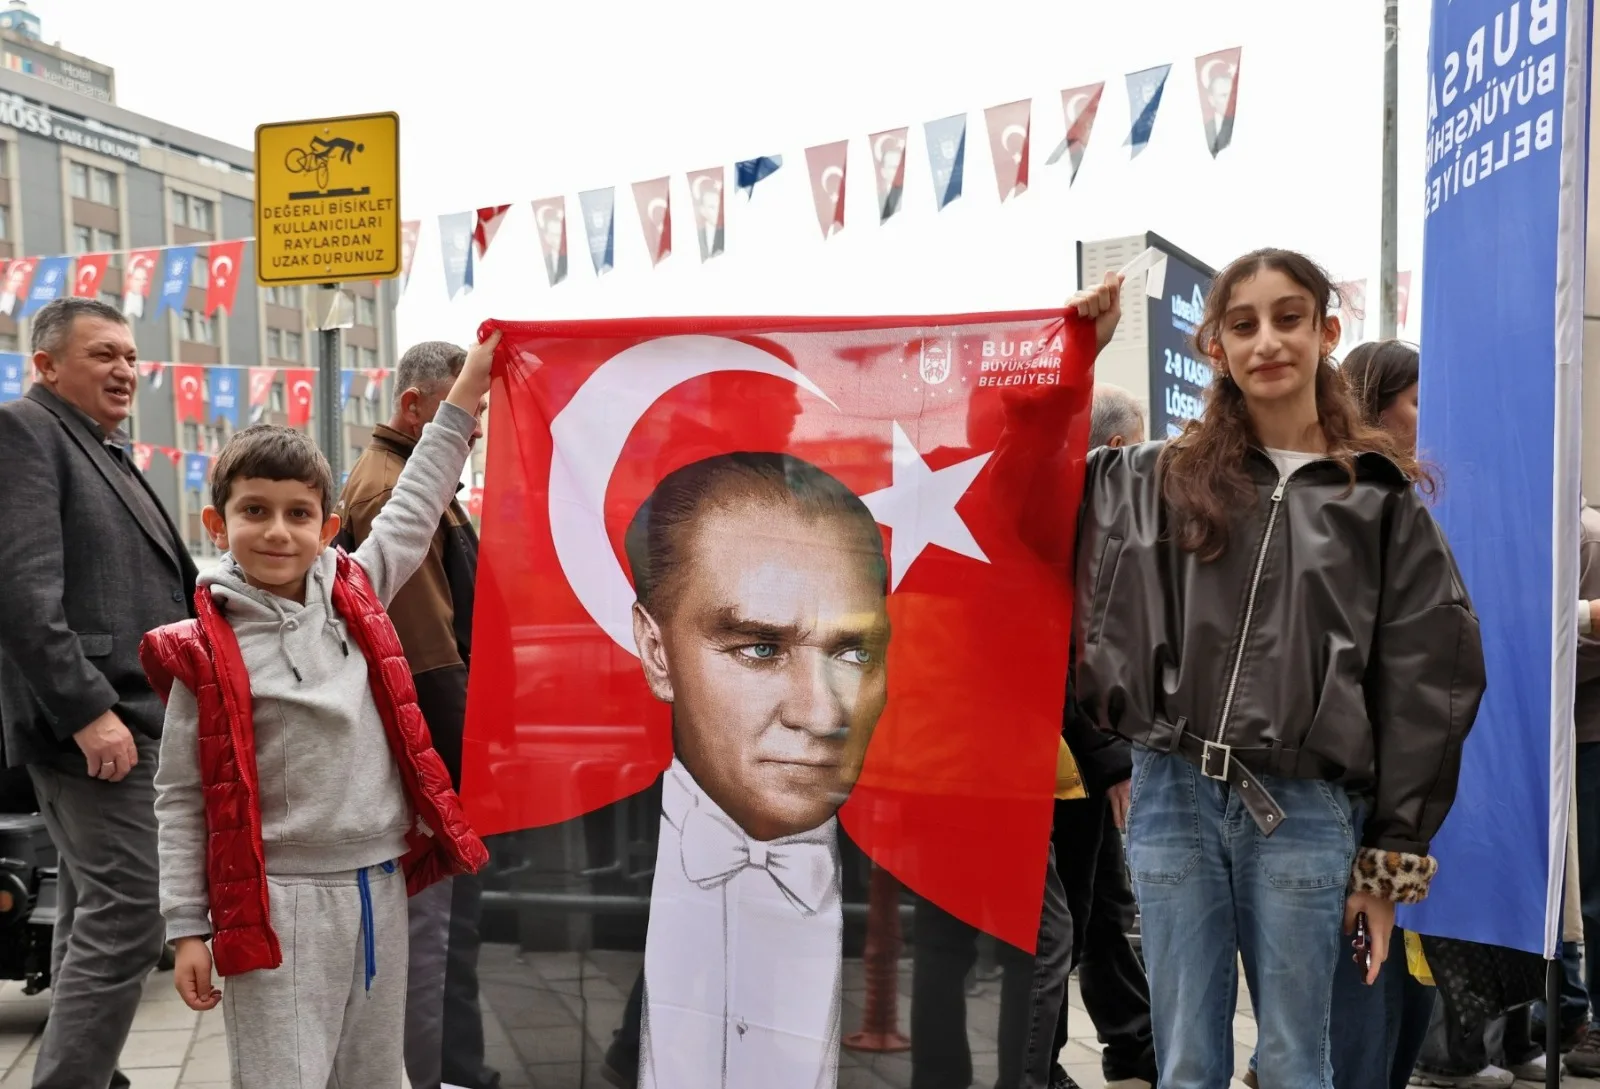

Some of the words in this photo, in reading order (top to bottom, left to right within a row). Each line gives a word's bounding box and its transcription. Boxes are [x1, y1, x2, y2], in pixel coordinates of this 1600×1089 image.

[264, 201, 325, 219] DEĞERLİ
[329, 198, 393, 215] BİSİKLET
[273, 216, 382, 235] KULLANICILARI
[284, 234, 371, 251] RAYLARDAN
[272, 254, 309, 267] UZAK
[313, 249, 384, 265] DURUNUZ
[981, 335, 1064, 357] BURSA
[1164, 348, 1182, 378] 2-8
[978, 370, 1060, 387] BELEDİYESİ
